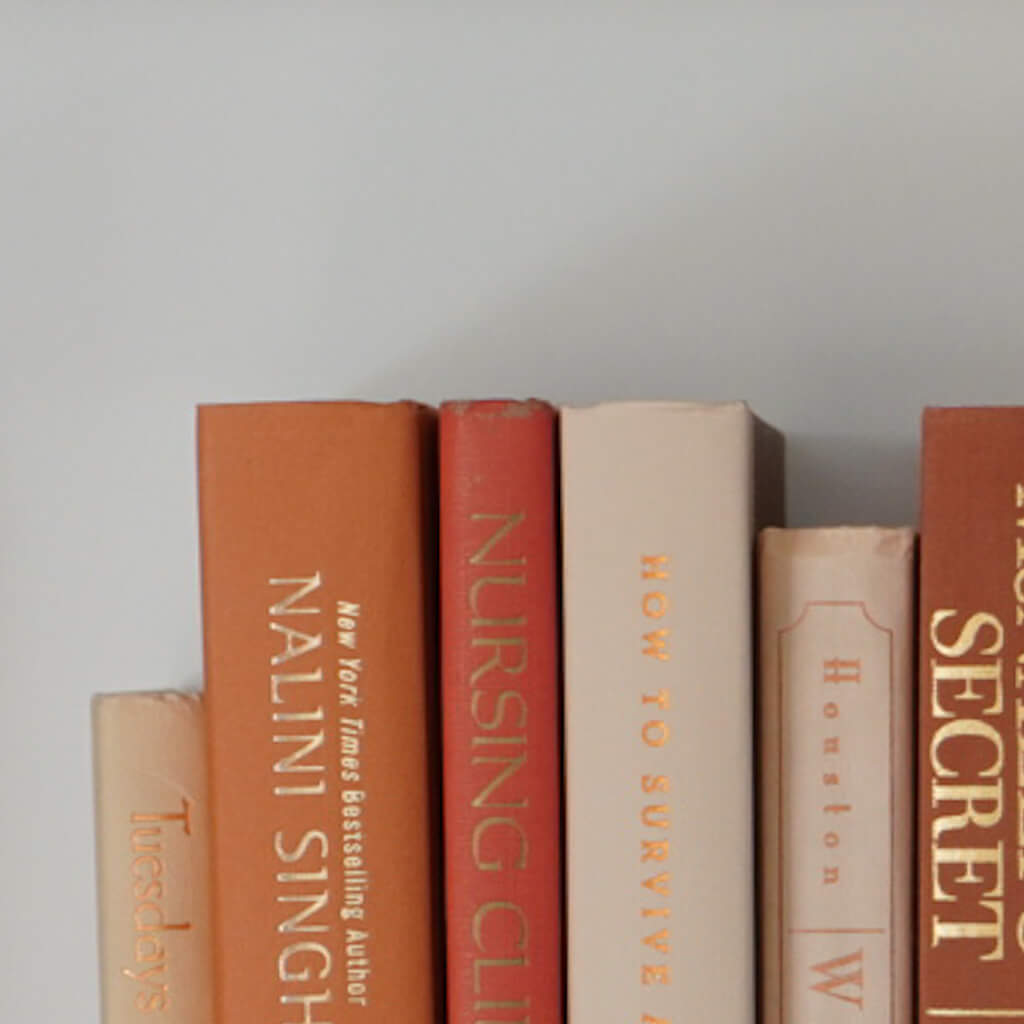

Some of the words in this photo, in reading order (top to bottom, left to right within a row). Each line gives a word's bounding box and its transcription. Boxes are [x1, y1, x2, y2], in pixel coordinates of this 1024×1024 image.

[336, 599, 360, 650] New
[640, 554, 671, 662] HOW
[268, 571, 326, 797] NALINI
[337, 658, 364, 708] York
[339, 715, 364, 783] Times
[468, 511, 529, 871] NURSING
[640, 688, 671, 748] TO
[822, 656, 862, 886] Houston
[929, 607, 1005, 962] SECRET
[122, 797, 193, 1014] Tuesdays
[340, 789, 368, 922] Bestselling
[640, 774, 672, 986] SURVIVE
[344, 928, 369, 1007] Author
